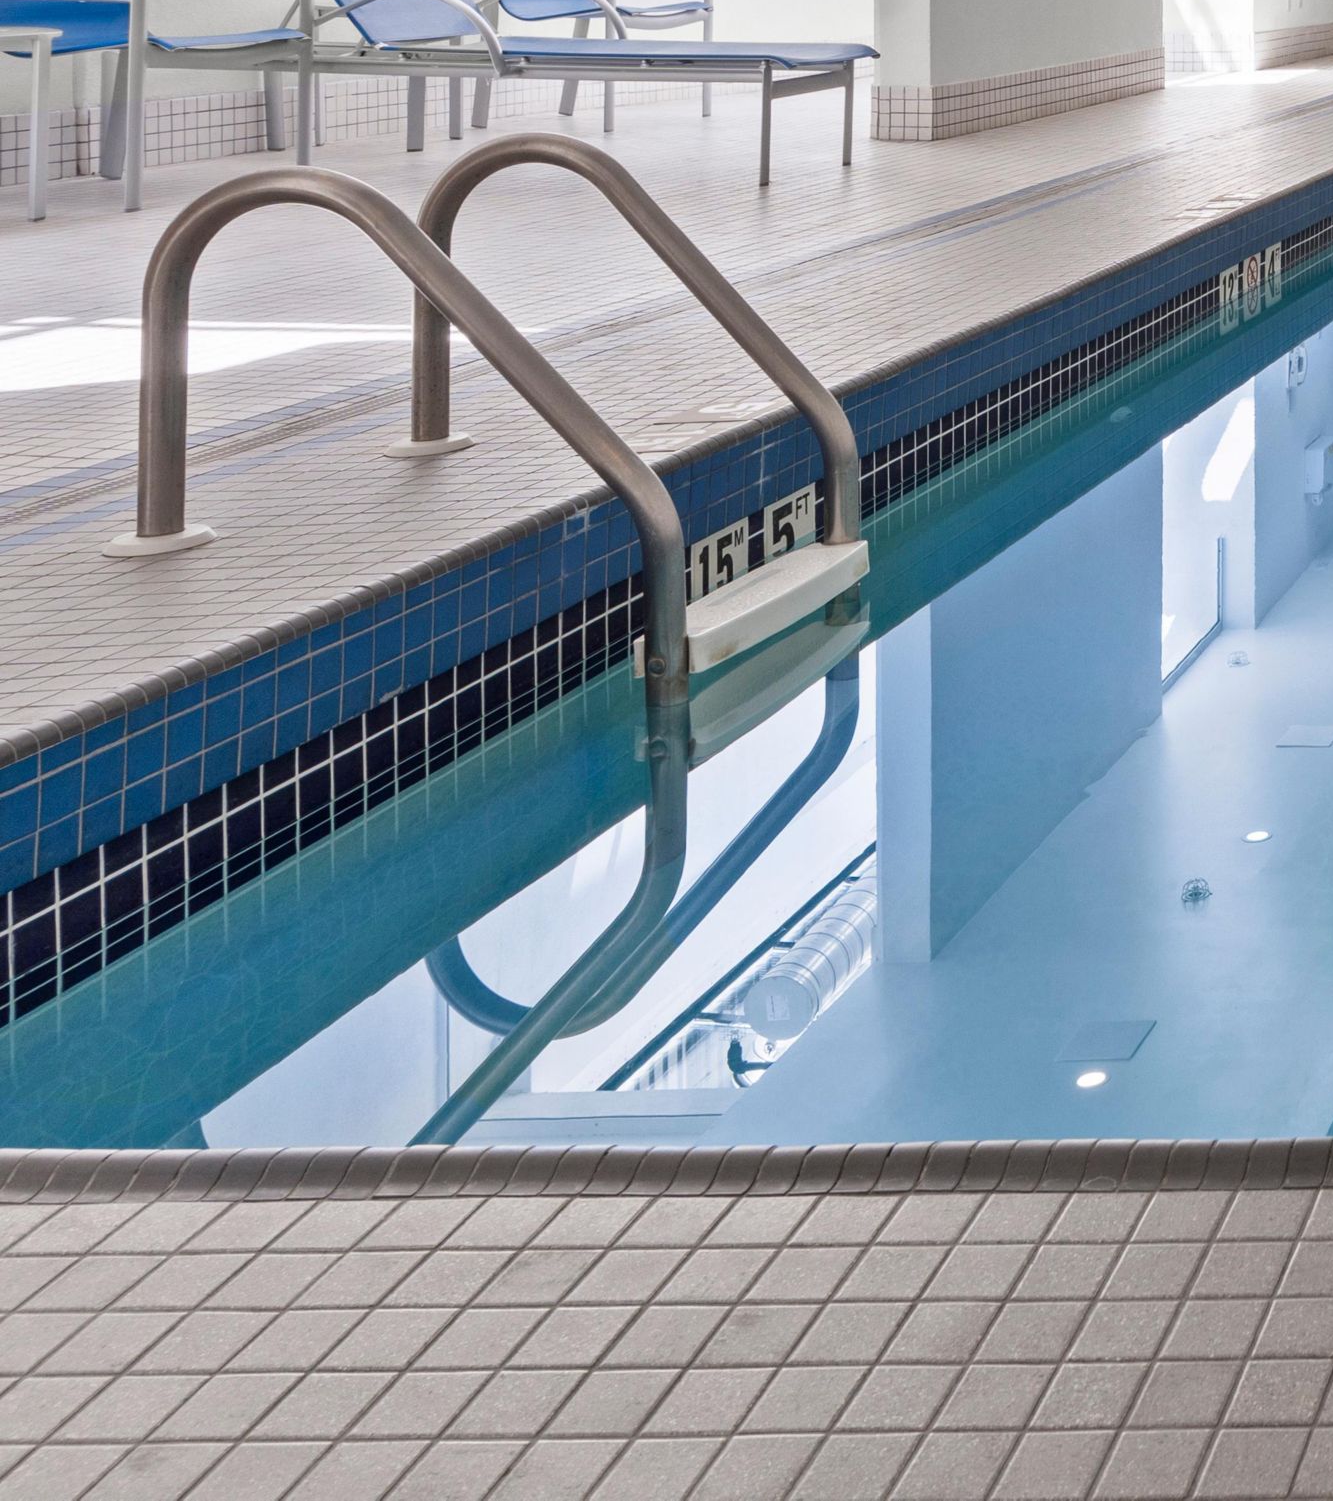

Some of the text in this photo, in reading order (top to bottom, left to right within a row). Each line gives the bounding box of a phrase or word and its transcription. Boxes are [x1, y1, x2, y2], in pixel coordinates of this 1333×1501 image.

[1268, 250, 1275, 280] 4
[772, 491, 810, 557] 5 FT
[699, 526, 744, 596] 15 M
